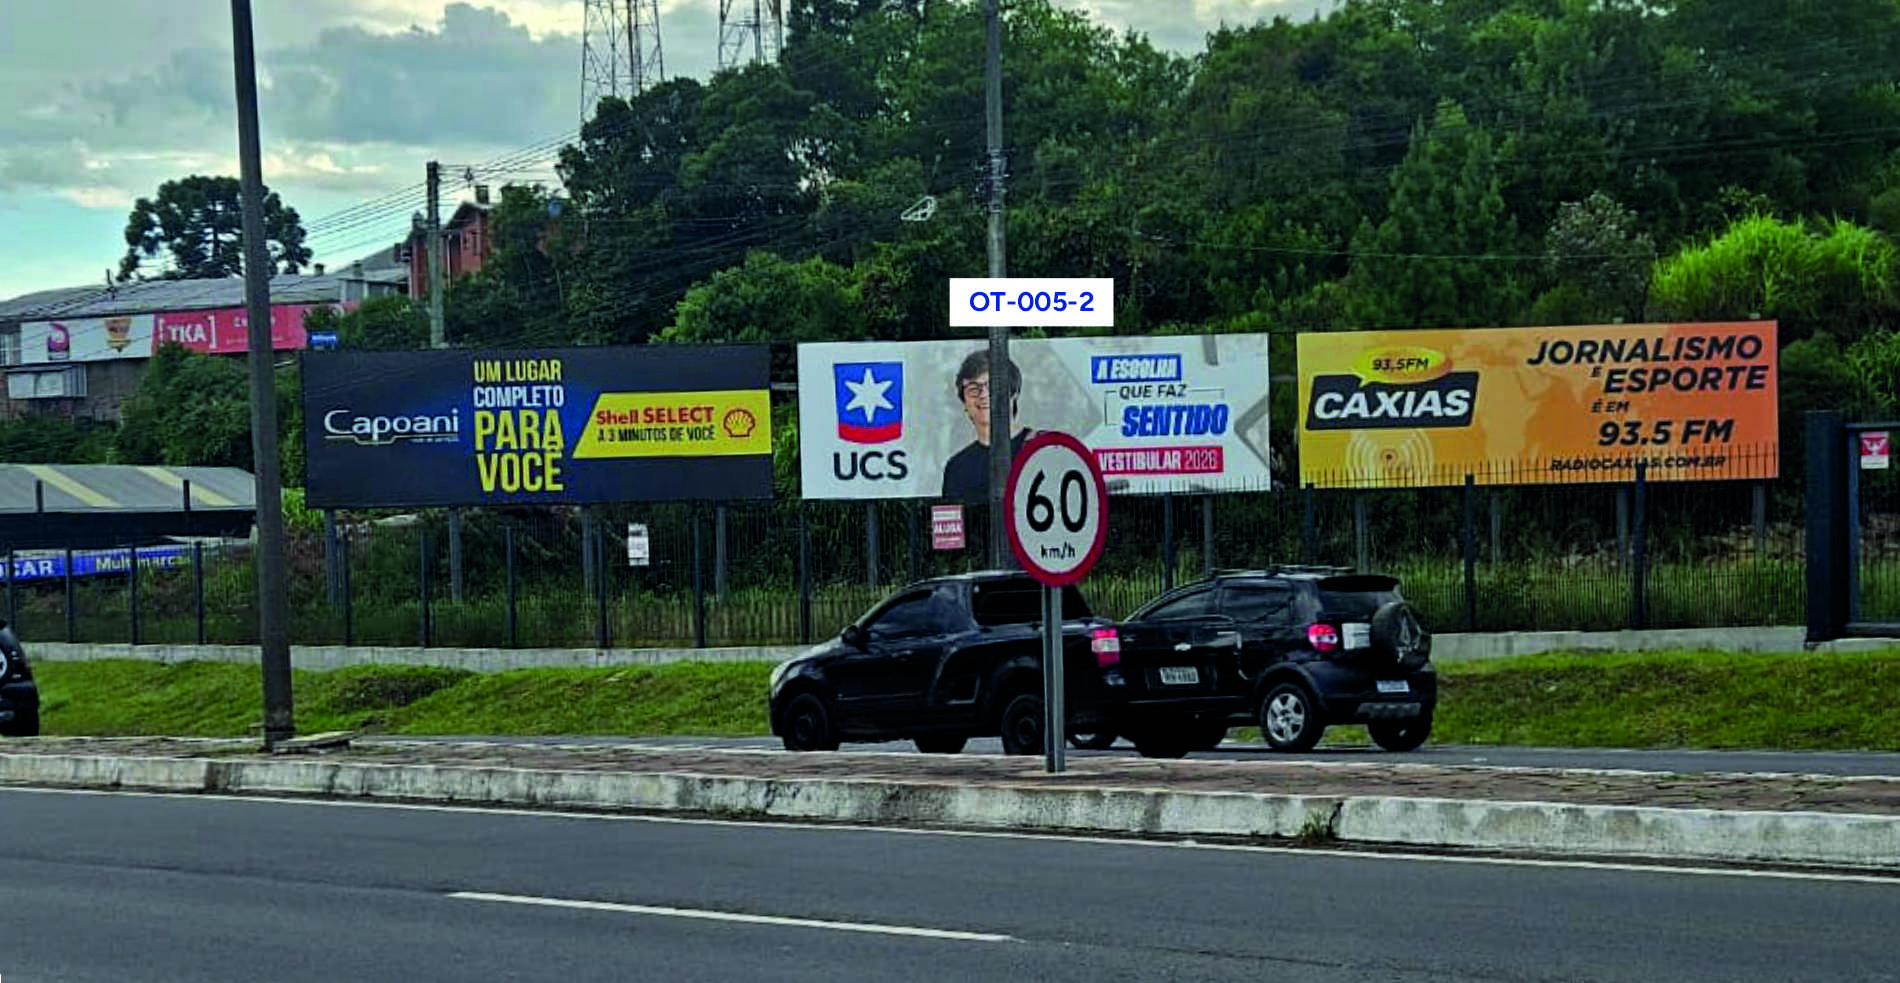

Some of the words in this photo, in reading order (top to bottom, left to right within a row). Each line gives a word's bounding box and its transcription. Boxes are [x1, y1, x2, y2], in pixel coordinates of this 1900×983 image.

[1527, 334, 1763, 365] JORNALISMO
[474, 360, 501, 382] UM
[505, 359, 562, 382] LUGAR
[1097, 359, 1108, 379] A
[1110, 357, 1178, 379] ESCOLHA
[1590, 366, 1602, 378] E
[1603, 365, 1769, 393] ESPORTE
[473, 385, 565, 408] COMPLETO
[1119, 385, 1153, 400] QUE
[1157, 384, 1188, 398] FAZ
[1314, 389, 1471, 419] CAXIAS
[596, 409, 638, 425] Shell
[643, 406, 714, 424] SELECT
[1606, 401, 1630, 413] EM
[324, 407, 459, 441] Capoani
[474, 408, 564, 451] PARA
[1121, 403, 1229, 437] SENTIDO
[1599, 420, 1673, 446] 93.5
[1680, 418, 1735, 444] FM
[619, 426, 667, 442] MINUTOS
[669, 427, 684, 442] DE
[476, 441, 564, 493] VOCÊ
[833, 450, 908, 481] UCS
[1100, 450, 1180, 472] VESTIBULAR
[1026, 468, 1087, 533] 60
[1041, 541, 1076, 560] km/h
